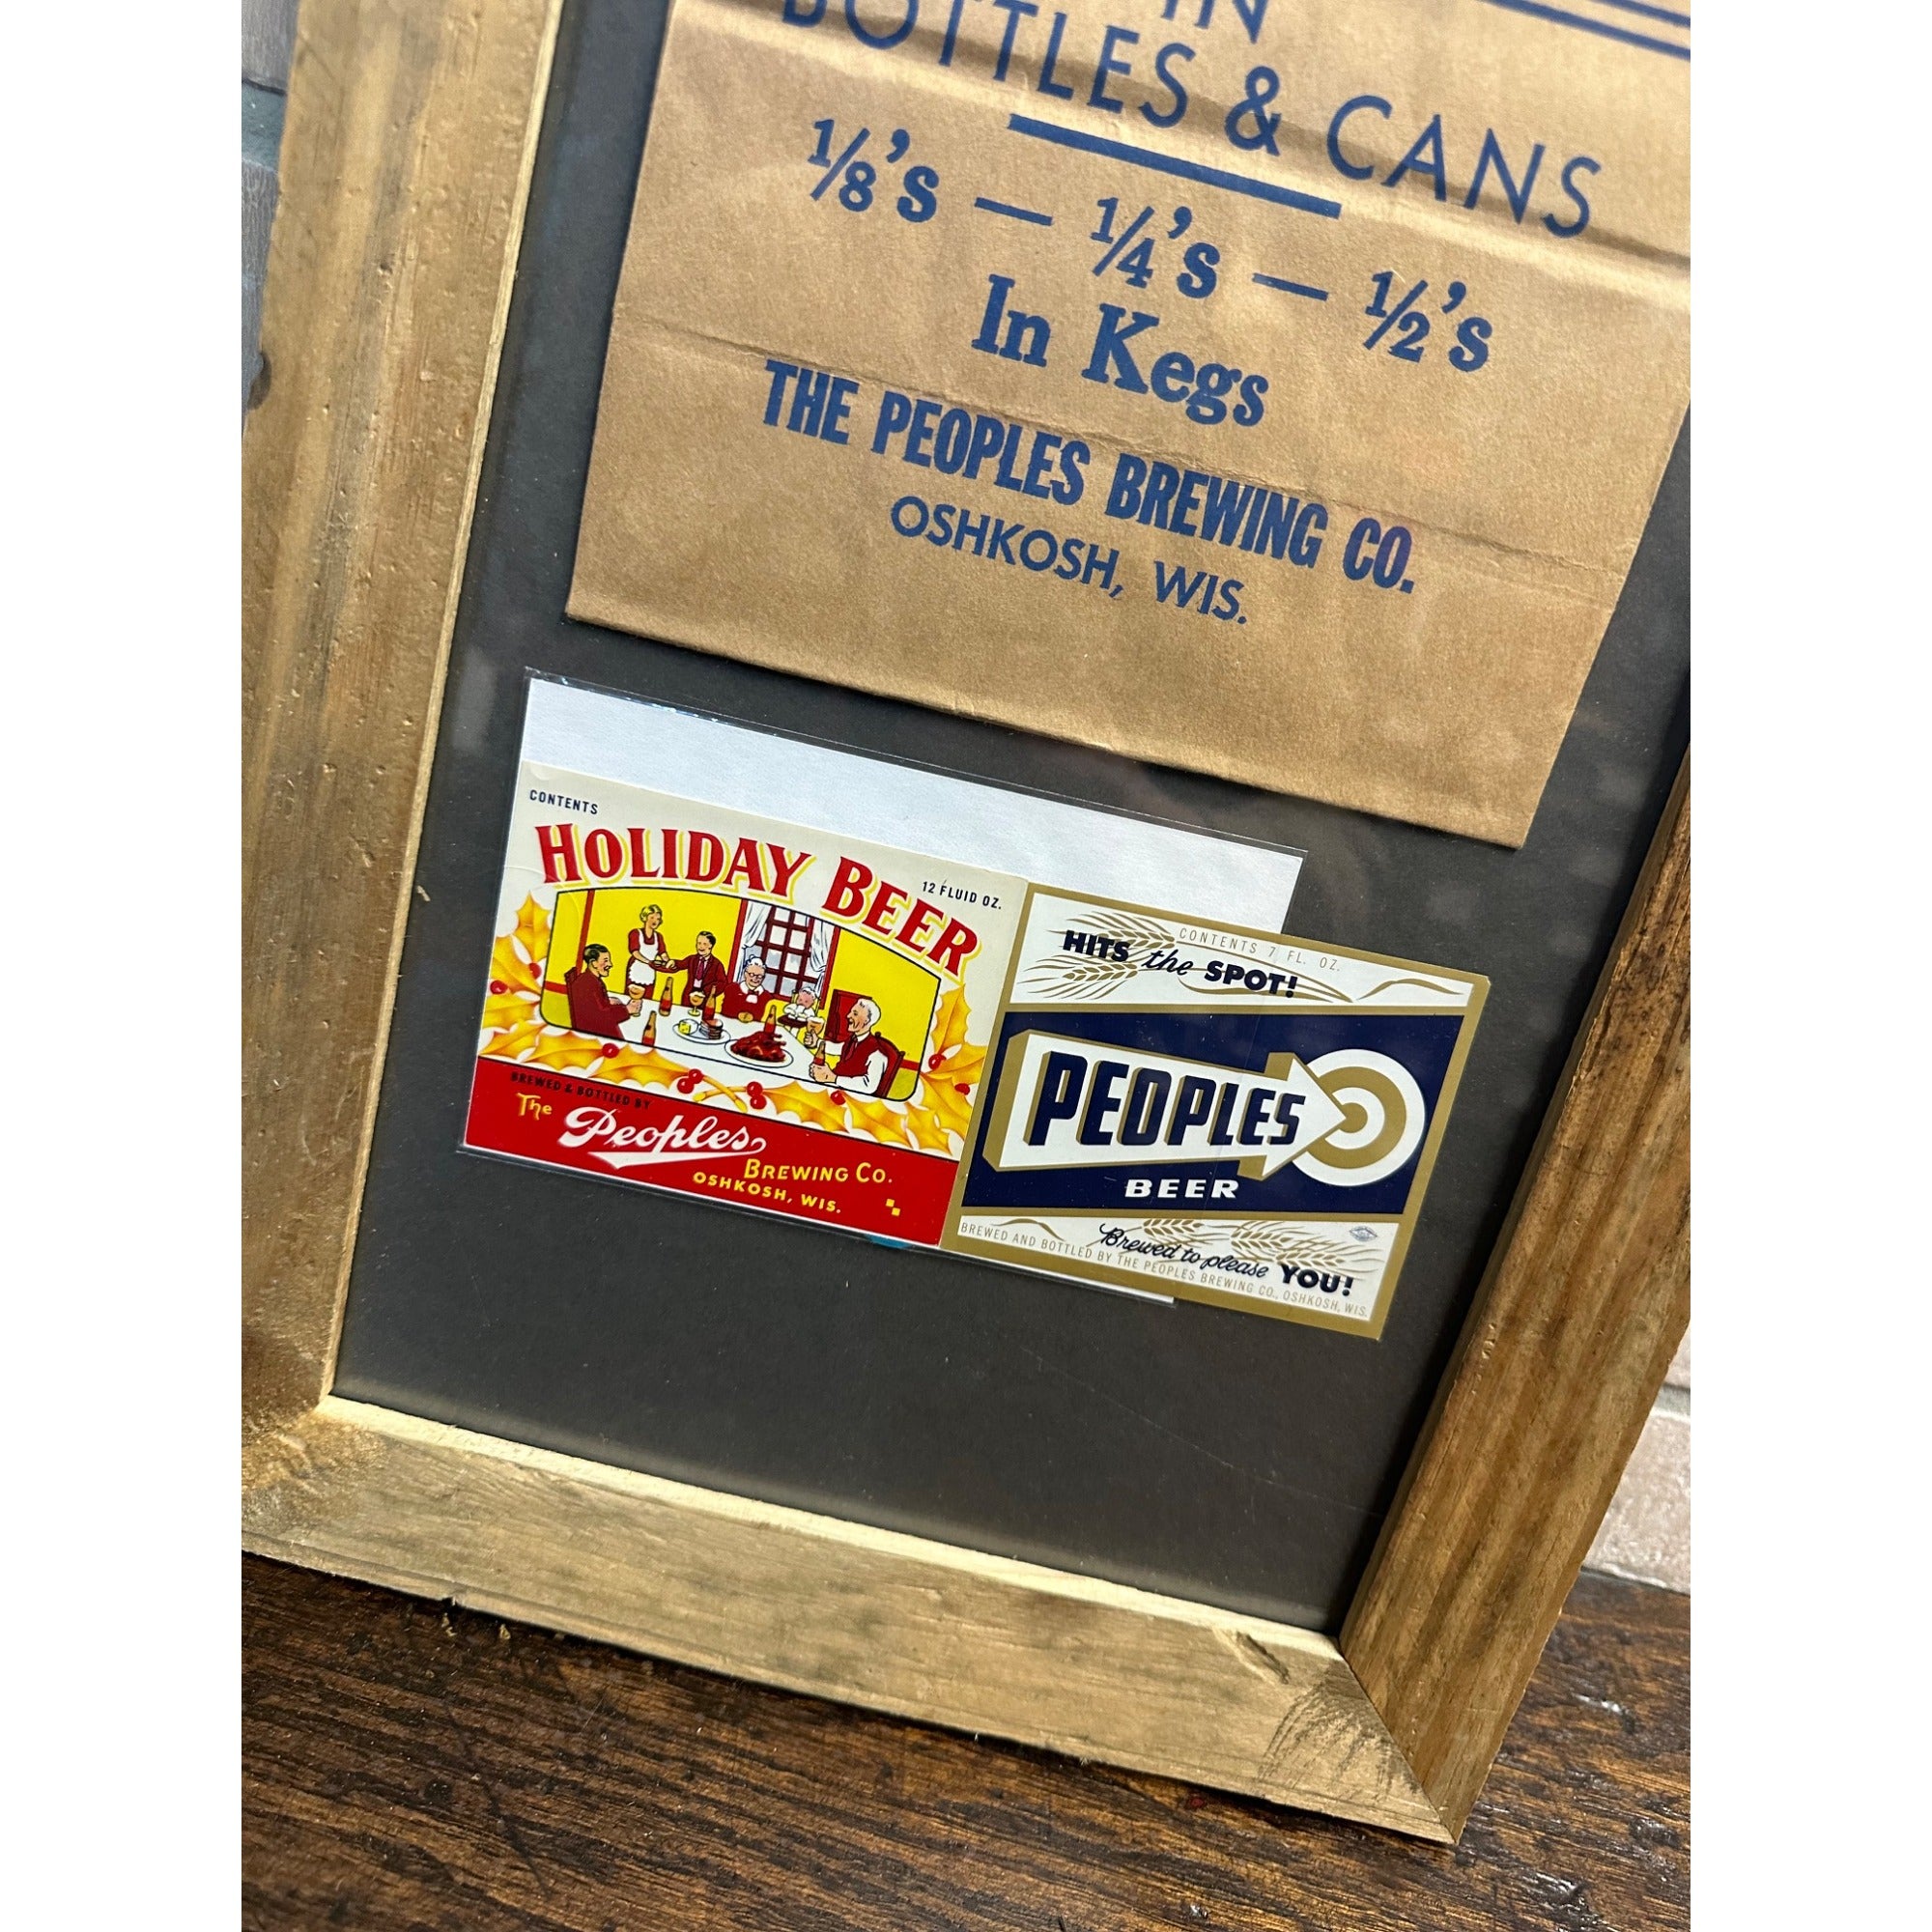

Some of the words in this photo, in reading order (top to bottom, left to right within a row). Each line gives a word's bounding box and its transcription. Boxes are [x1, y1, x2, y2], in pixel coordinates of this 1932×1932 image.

[1225, 66, 1281, 156] &
[1326, 94, 1601, 239] CANS
[971, 274, 1052, 369] In
[1081, 302, 1269, 427] Kegs
[763, 359, 861, 444] THE
[871, 392, 1092, 505] PEOPLES
[1105, 453, 1332, 569] BREWING
[1343, 518, 1415, 594] CO.
[890, 496, 1124, 599] OSHKOSH,
[1154, 561, 1248, 624] WIS.
[528, 789, 599, 816] CONTENTS
[534, 823, 814, 902] HOLIDAY
[822, 856, 981, 981] BEER
[922, 880, 935, 894] 12
[940, 883, 978, 903] FLUID
[981, 895, 1003, 911] OZ.
[1063, 929, 1130, 962] HITS
[1141, 948, 1195, 977] the
[1204, 959, 1299, 999] SPOT!
[1179, 927, 1259, 954] CONTENTS
[1268, 945, 1278, 958] 7
[1287, 950, 1307, 965] FL.
[1320, 956, 1341, 972] OZ.
[510, 1070, 560, 1093] BREWED
[564, 1083, 573, 1094] &
[577, 1086, 630, 1107] BOTTLED
[634, 1096, 652, 1110] BY
[1022, 1050, 1307, 1148] PEOPLES
[516, 1092, 554, 1121] The
[557, 1106, 767, 1161] Peoples
[693, 1170, 794, 1206] OSHKOSH,
[801, 1192, 841, 1214] WIS.
[744, 1156, 849, 1183] BREWING
[1124, 1179, 1241, 1200] BEER
[960, 1221, 1008, 1242] BREWED
[1011, 1233, 1037, 1247] AND
[1040, 1237, 1093, 1260] BOTTLED
[1097, 1249, 1112, 1264] BY
[1118, 1253, 1138, 1269] THE
[1144, 1260, 1196, 1282] PEOPLES
[1201, 1271, 1253, 1293] BREWING
[1283, 1289, 1341, 1313] OSHKOSH,
[1345, 1302, 1368, 1318] WIS.
[1099, 1222, 1181, 1260] Brewed
[1180, 1245, 1202, 1264] to
[1200, 1253, 1269, 1278] please
[1280, 1264, 1354, 1296] YOU!
